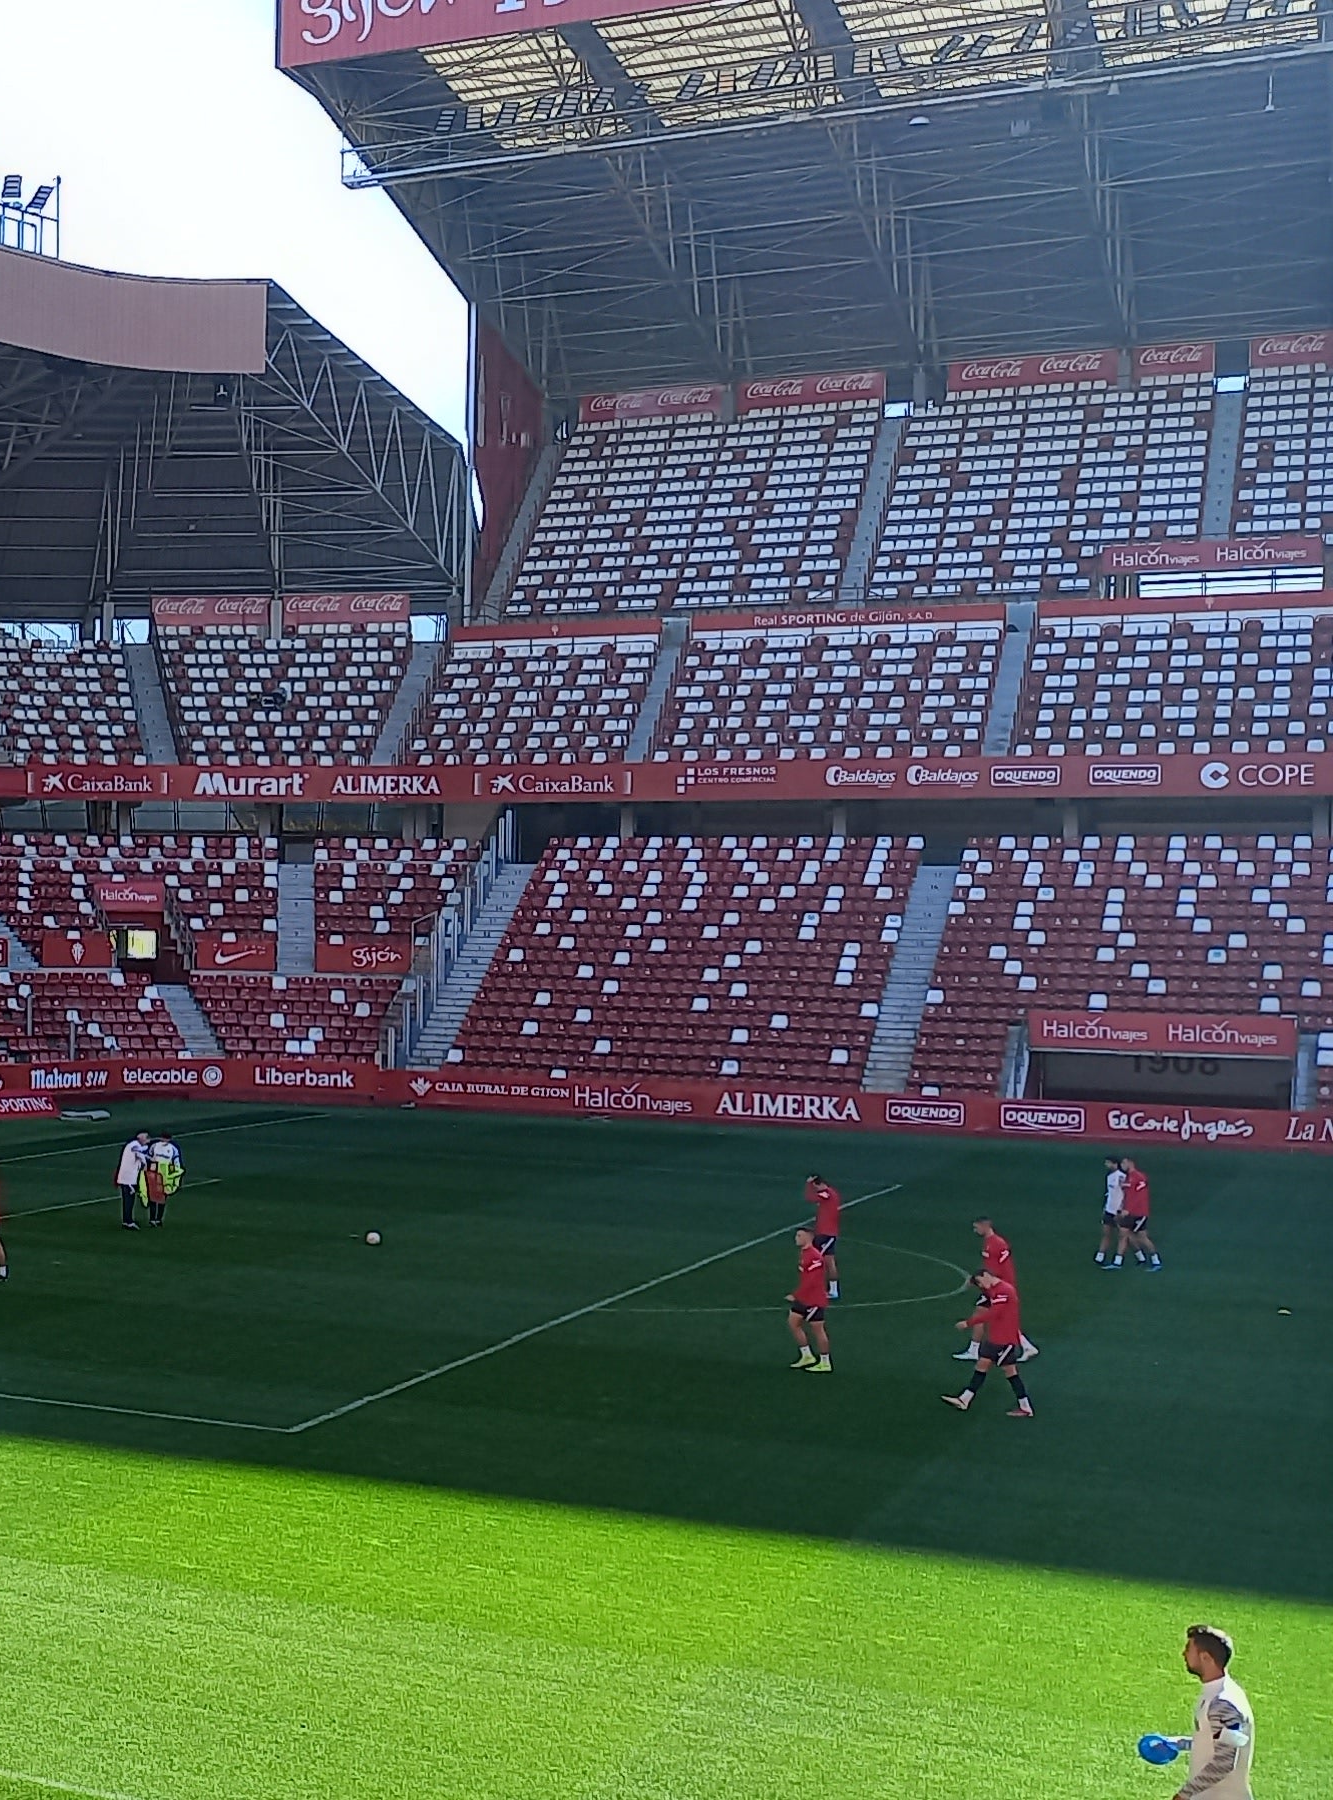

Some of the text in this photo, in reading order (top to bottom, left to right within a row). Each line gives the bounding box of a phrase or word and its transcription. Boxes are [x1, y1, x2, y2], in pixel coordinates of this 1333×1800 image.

[754, 615, 778, 627] Real
[782, 613, 846, 626] SPORTING
[850, 612, 865, 625] de
[697, 766, 777, 776] LOS FRESNOS
[994, 769, 1057, 783] OQUENDO
[1094, 768, 1157, 782] OQUENDO
[1238, 764, 1315, 786] COPE
[68, 774, 153, 793] CaixaBank
[194, 772, 305, 796] Murart
[332, 775, 441, 796] ALIMERKA
[518, 775, 615, 794] CaixaBank
[351, 944, 403, 967] gijón
[30, 1068, 108, 1090] Mahou SIN
[122, 1068, 198, 1086] telecable
[254, 1067, 354, 1088] Liberbank
[467, 1083, 508, 1096] RURAL
[510, 1085, 528, 1096] DE
[715, 1092, 861, 1122] ALIMERKA
[890, 1105, 959, 1121] OQUENDO
[1005, 1109, 1080, 1125] OQUENDO
[1108, 1110, 1129, 1130] El
[1285, 1116, 1314, 1141] La
